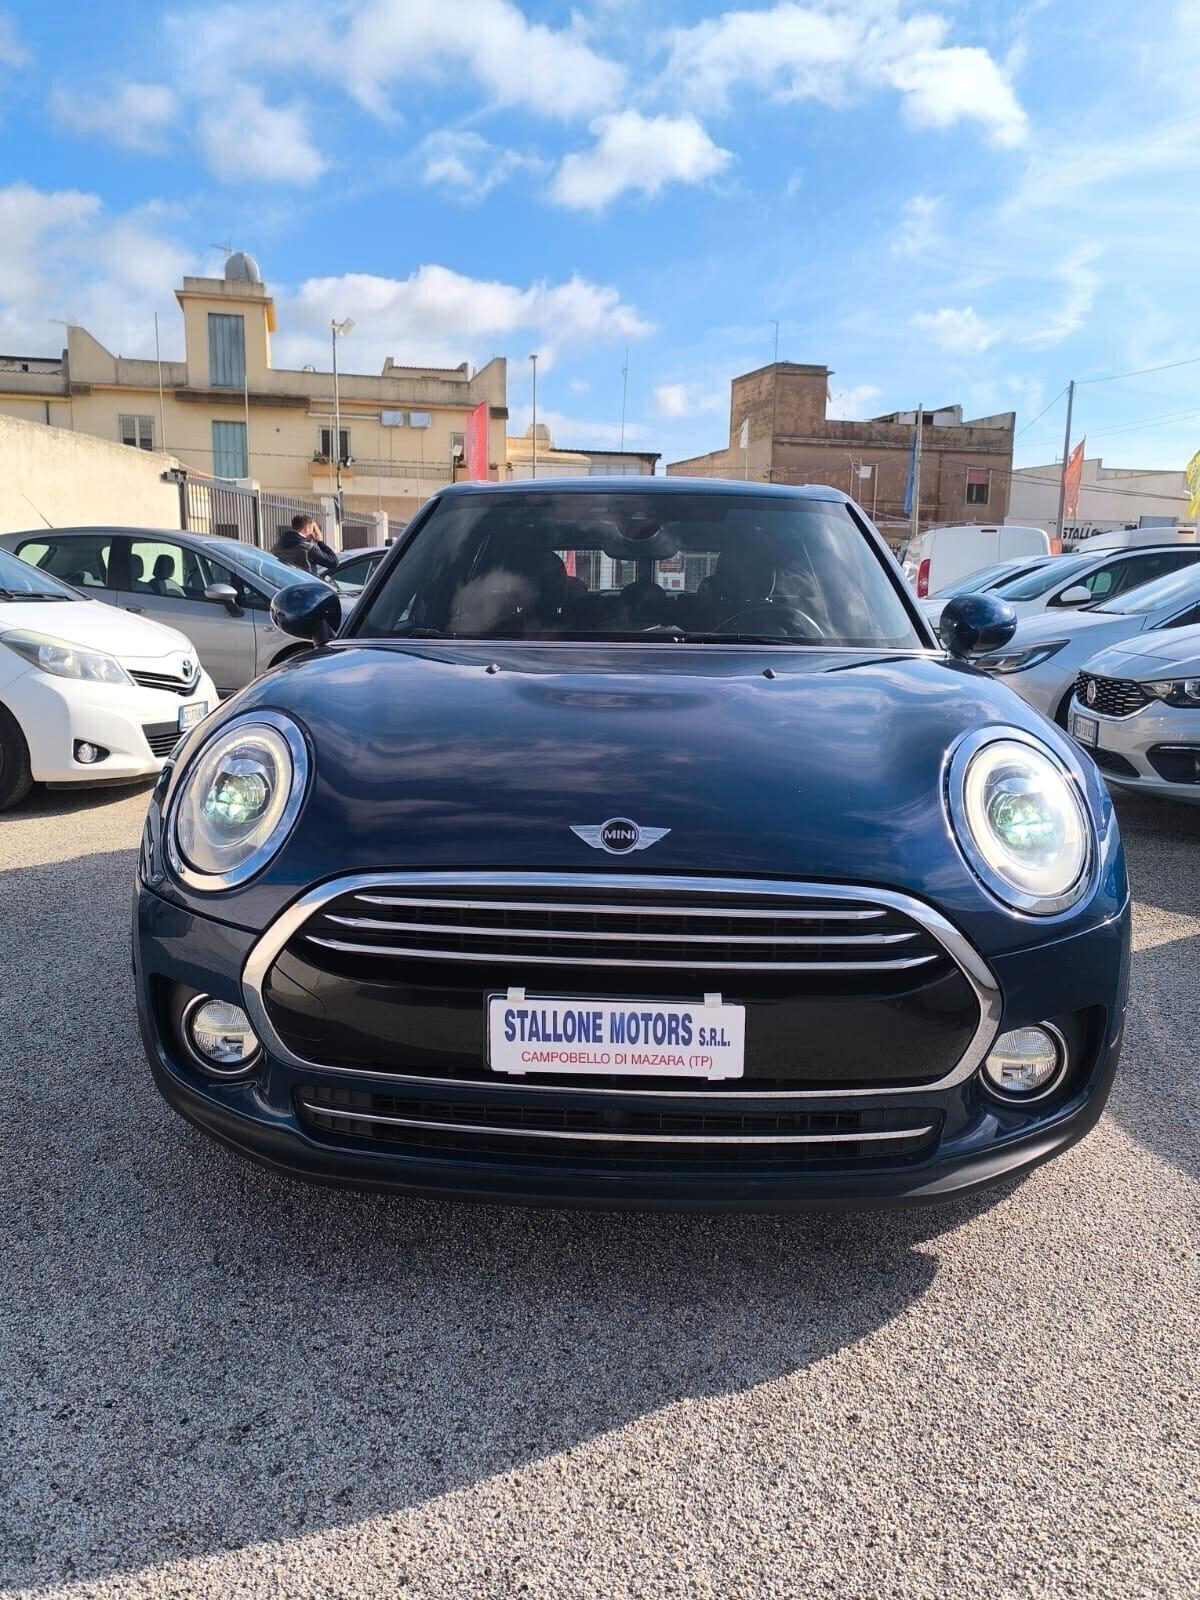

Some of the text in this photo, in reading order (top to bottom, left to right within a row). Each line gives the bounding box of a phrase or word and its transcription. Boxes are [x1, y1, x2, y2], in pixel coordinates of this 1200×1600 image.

[604, 829, 636, 840] MINI
[504, 1009, 731, 1047] STALLONE MOTORS S.R.L.
[521, 1051, 713, 1069] CAMPOBELLO DI MAZARA (TP)
